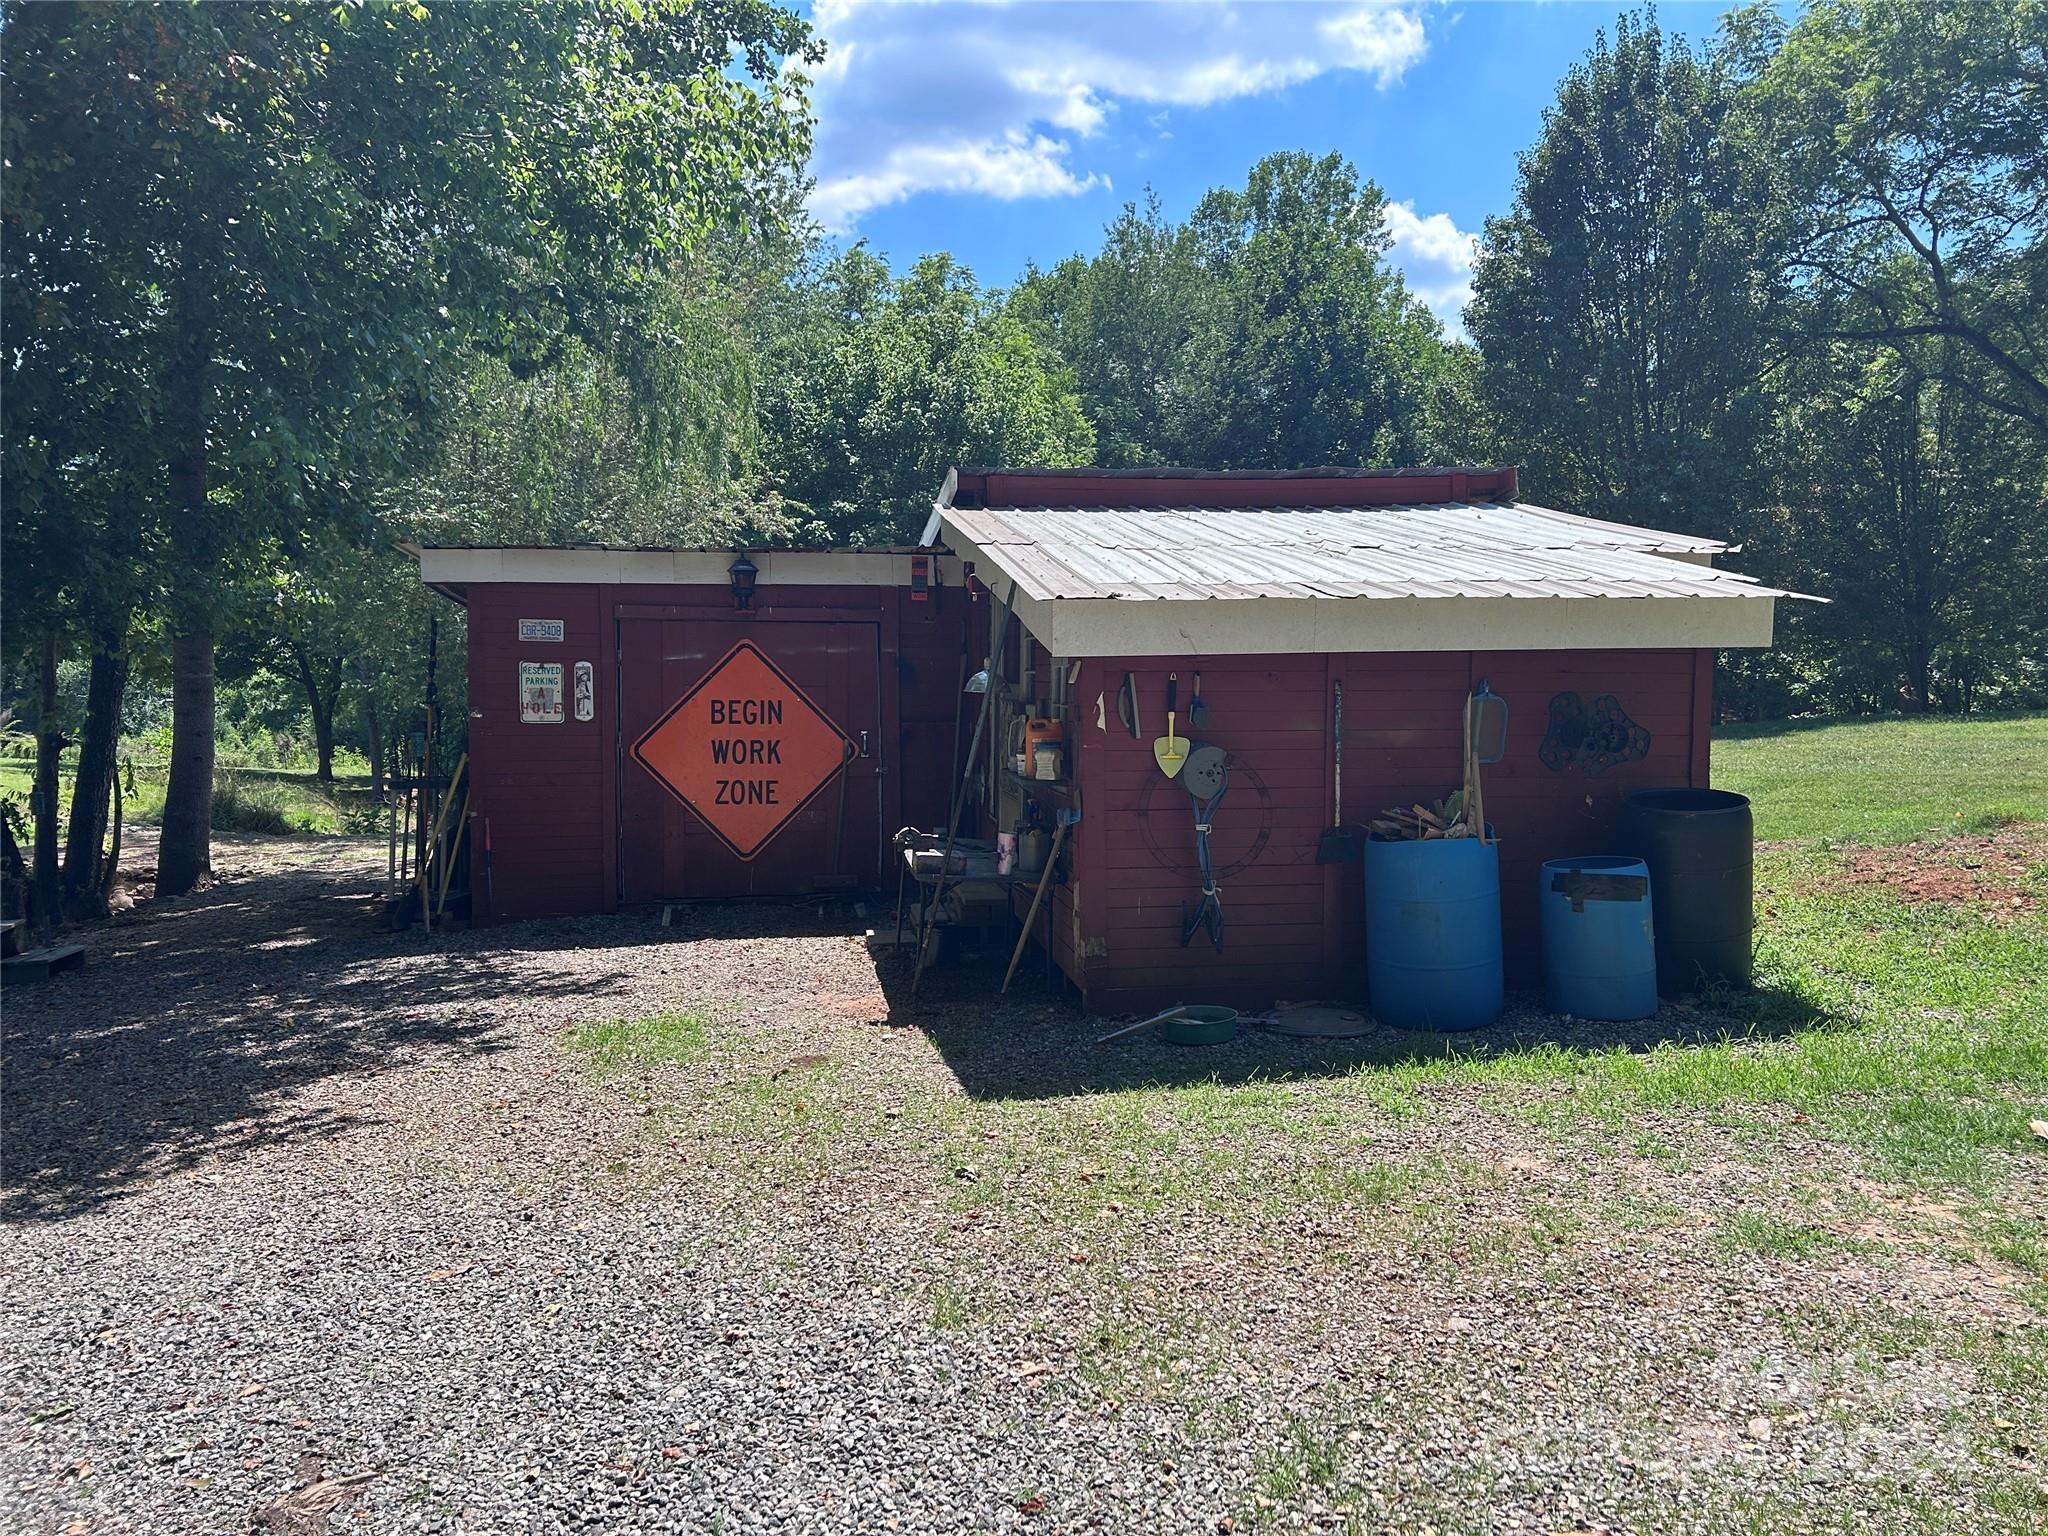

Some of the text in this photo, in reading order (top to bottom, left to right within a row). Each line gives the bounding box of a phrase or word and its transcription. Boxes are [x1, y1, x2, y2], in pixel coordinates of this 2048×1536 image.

[522, 666, 560, 675] RESERVED
[525, 677, 559, 685] PARKING
[538, 687, 545, 698] A
[521, 702, 562, 714] HOLE
[711, 699, 783, 724] BEGIN
[711, 739, 782, 764] WORK
[714, 780, 779, 804] ZONE
